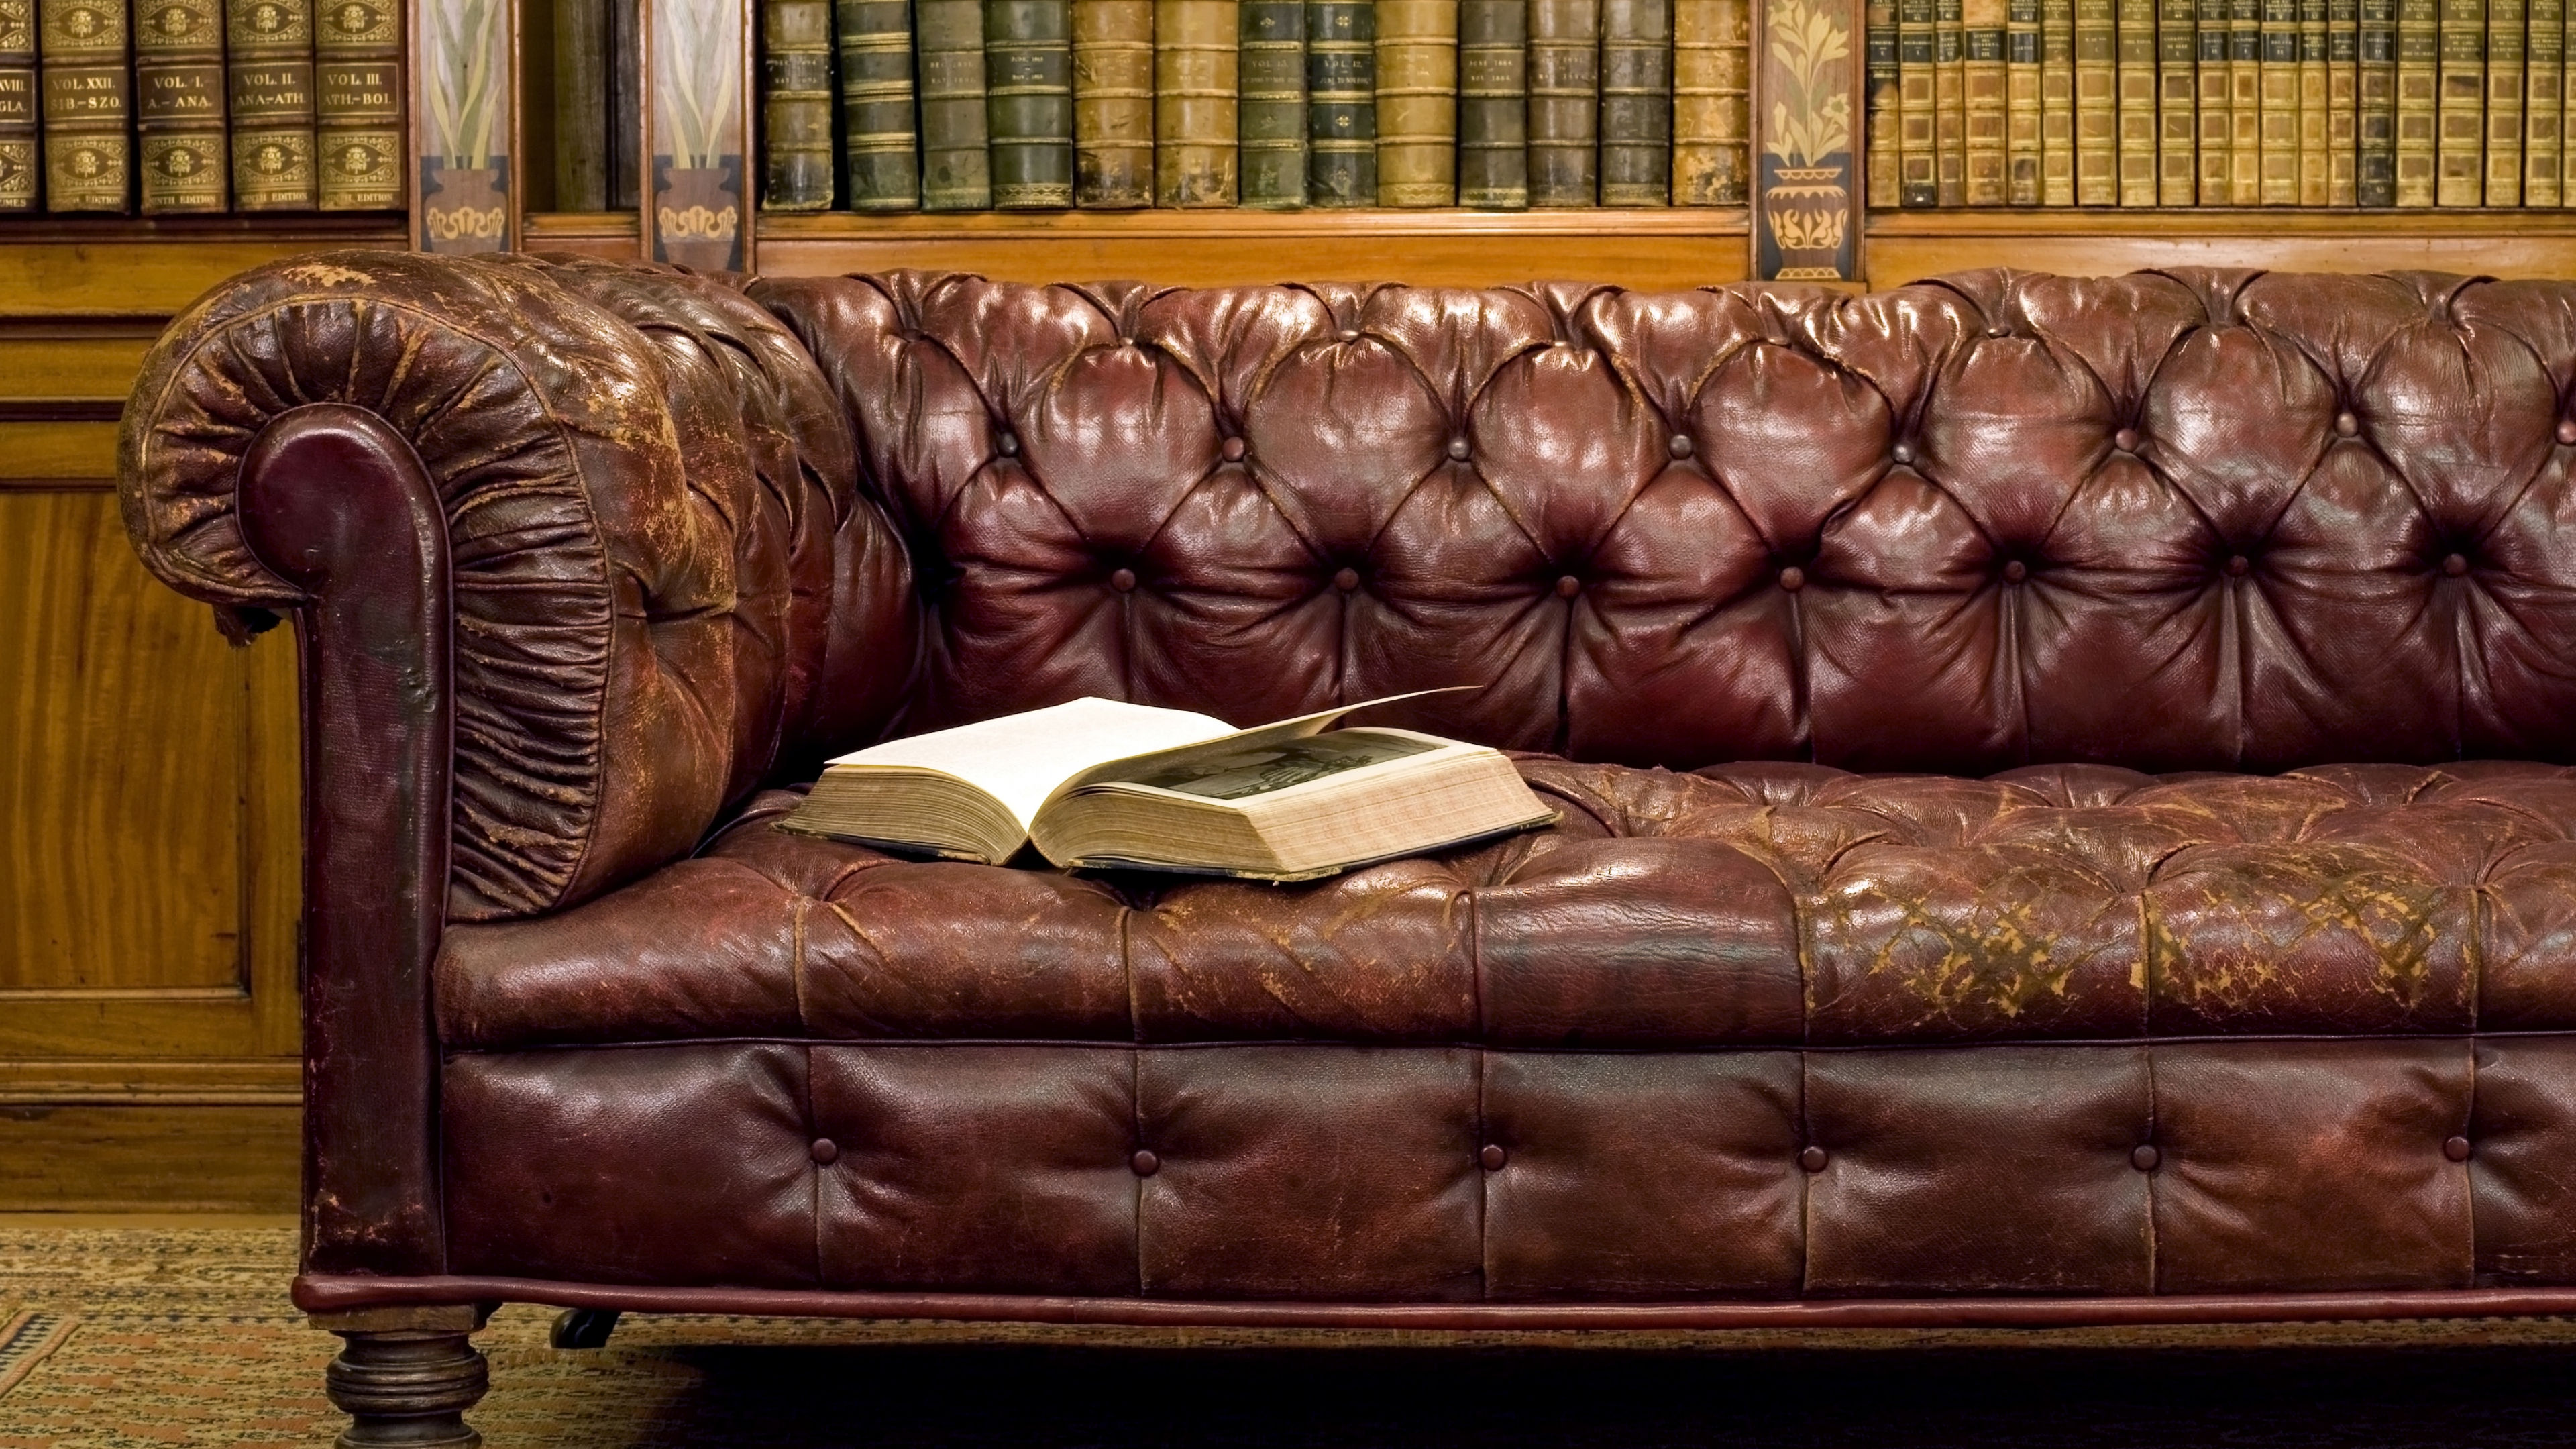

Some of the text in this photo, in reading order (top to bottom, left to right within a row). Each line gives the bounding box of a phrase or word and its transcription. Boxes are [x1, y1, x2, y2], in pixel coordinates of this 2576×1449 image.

[53, 77, 115, 90] VOL. XXII.
[154, 76, 203, 89] VOL. I.
[244, 73, 296, 85] VOL. II.
[327, 73, 382, 85] VOL. III.
[180, 195, 215, 204] EDITION
[272, 192, 308, 201] EDITION
[356, 193, 394, 201] EDITION
